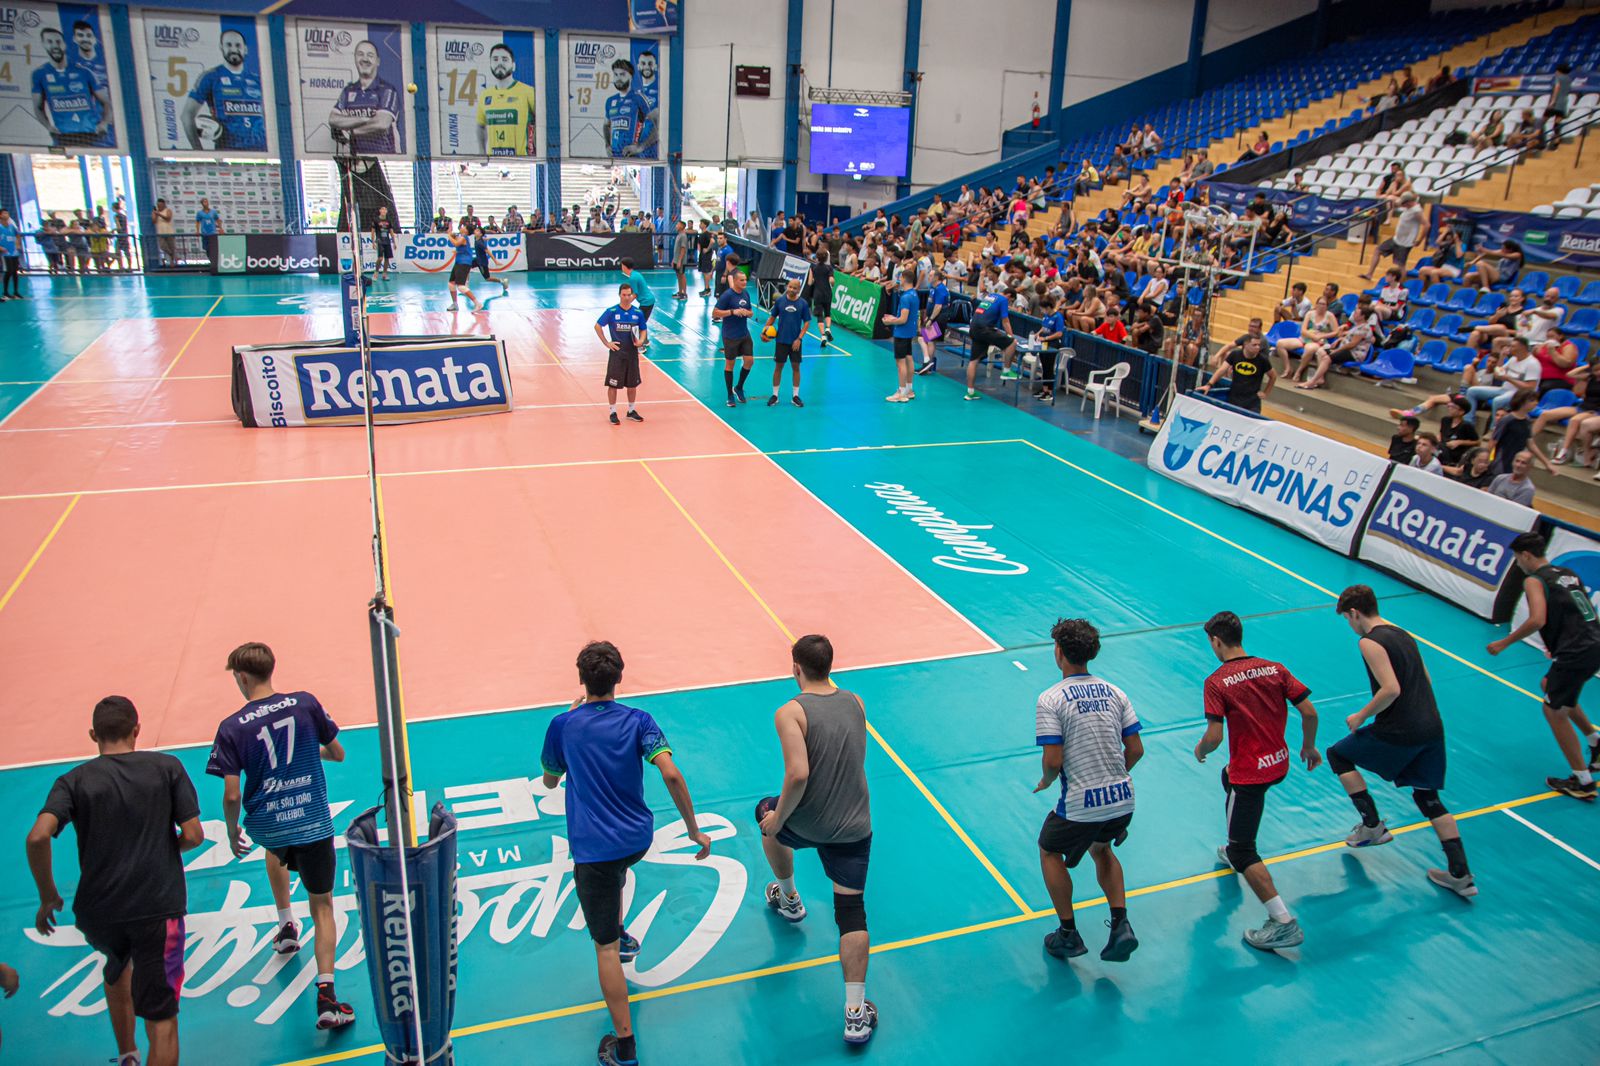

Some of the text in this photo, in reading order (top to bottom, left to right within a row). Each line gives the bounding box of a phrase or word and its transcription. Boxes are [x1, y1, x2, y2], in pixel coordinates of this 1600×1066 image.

[23, 43, 31, 65] 1
[167, 56, 188, 97] 5
[309, 76, 345, 88] HORÁCIO
[446, 68, 478, 107] 14
[595, 71, 611, 90] 10
[576, 87, 592, 105] 13
[243, 117, 252, 128] 5
[448, 113, 459, 148] LUKINHA
[495, 130, 505, 143] 14
[483, 232, 521, 248] ood
[1560, 234, 1600, 253] Renat
[220, 254, 330, 272] bt bodytech
[404, 246, 446, 260] Bom
[544, 257, 620, 267] PENALTY
[831, 284, 876, 325] Sicredi
[261, 354, 288, 427] Biscoito
[302, 356, 501, 411] Renata
[1209, 426, 1374, 491] PREFEITURA DE
[1197, 444, 1363, 528] CAMPINAS
[864, 481, 1030, 575] Campinas
[1376, 490, 1505, 577] Renata
[1222, 665, 1279, 688] PRAIA GRANDE
[1062, 683, 1115, 702] LOUVEIRA
[1076, 699, 1110, 715] ESPORTE
[256, 715, 296, 770] 17
[1257, 747, 1289, 770] ATLETA
[280, 796, 295, 809] SÃO
[295, 792, 312, 805] JOÃO
[1083, 780, 1133, 809] ATLETA
[275, 807, 306, 822] VOLEIBOL
